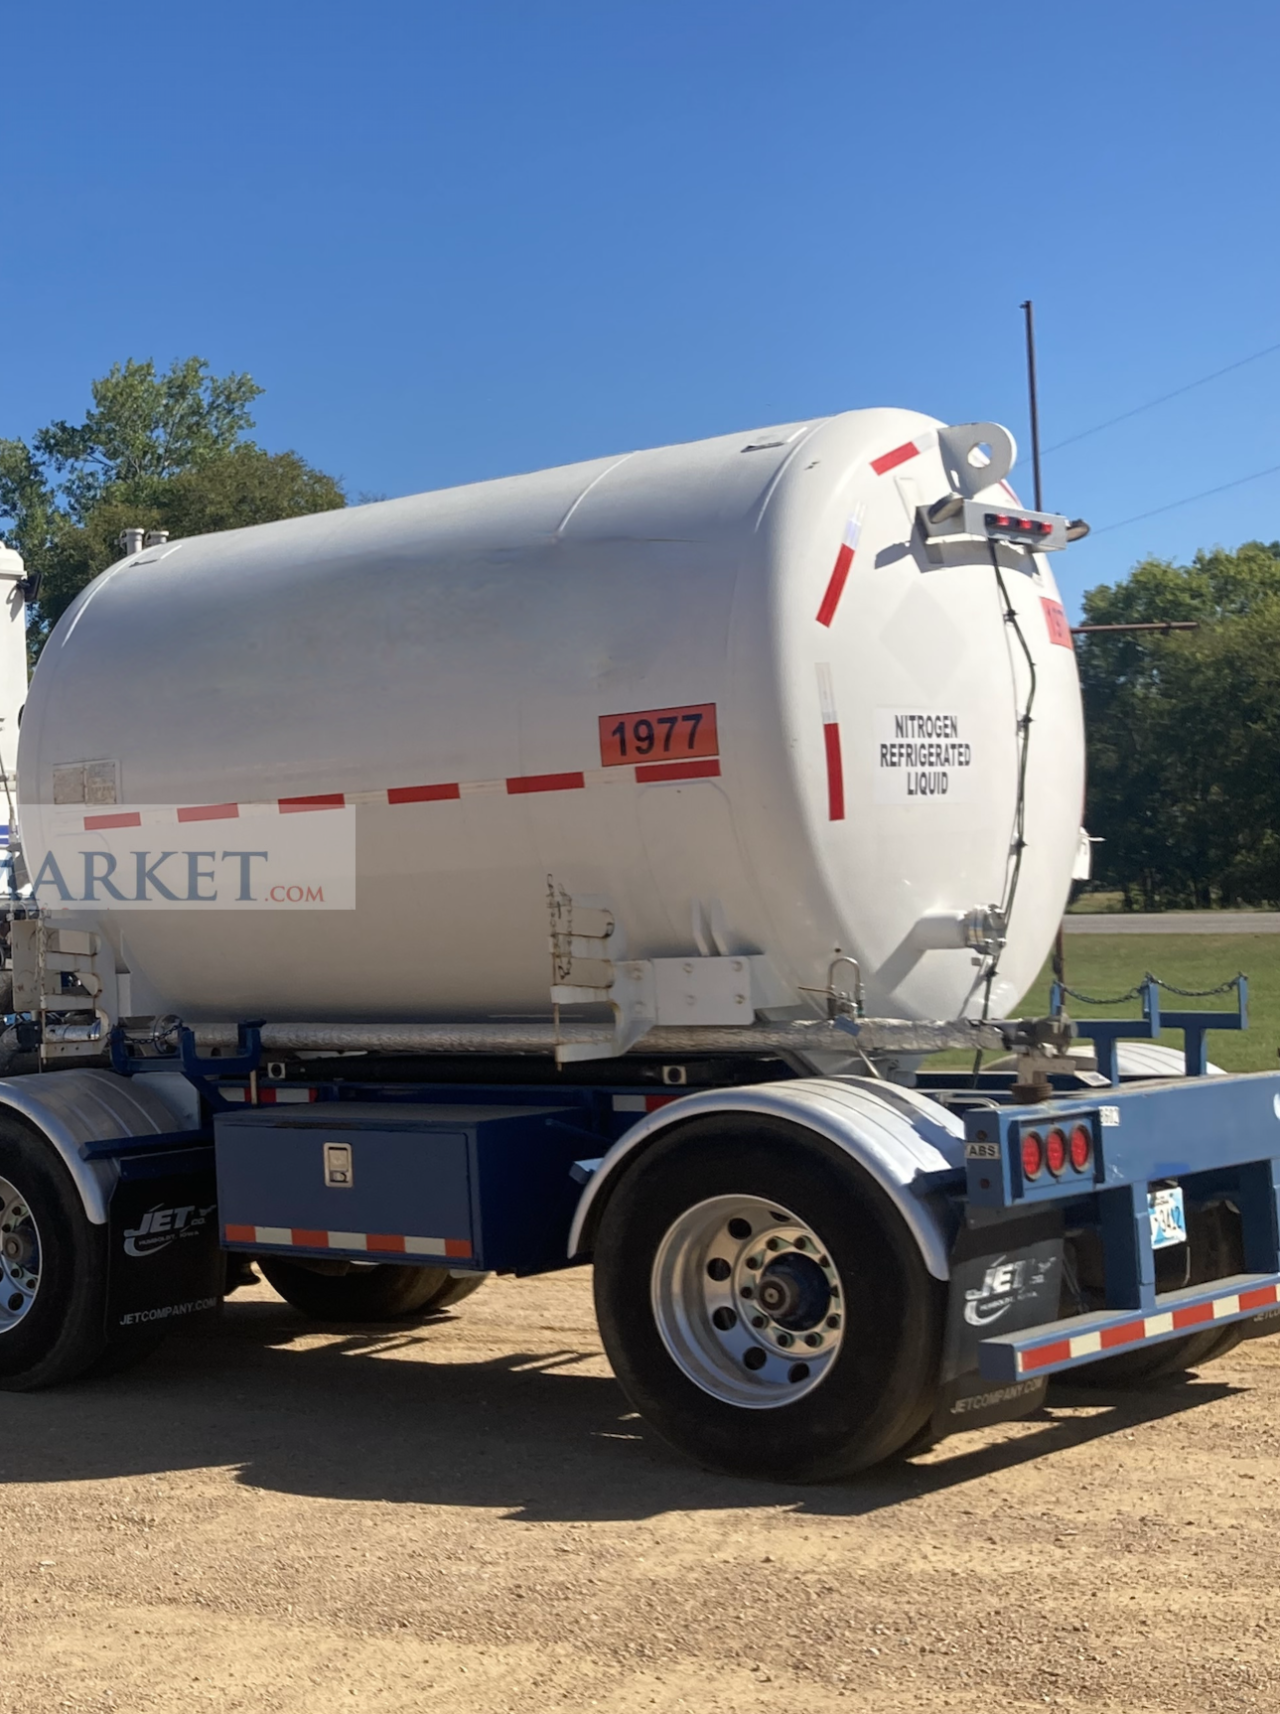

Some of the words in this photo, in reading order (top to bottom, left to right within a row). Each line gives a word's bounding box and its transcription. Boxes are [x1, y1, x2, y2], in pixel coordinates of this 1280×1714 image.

[612, 713, 703, 756] 1977
[894, 714, 958, 738] NITROGEN
[880, 743, 971, 767] REFRIGERATED
[907, 771, 948, 796] LIQUID
[969, 1144, 996, 1157] ABS
[124, 1205, 195, 1237] JET
[120, 1297, 217, 1326] JETCOMPANY.COM
